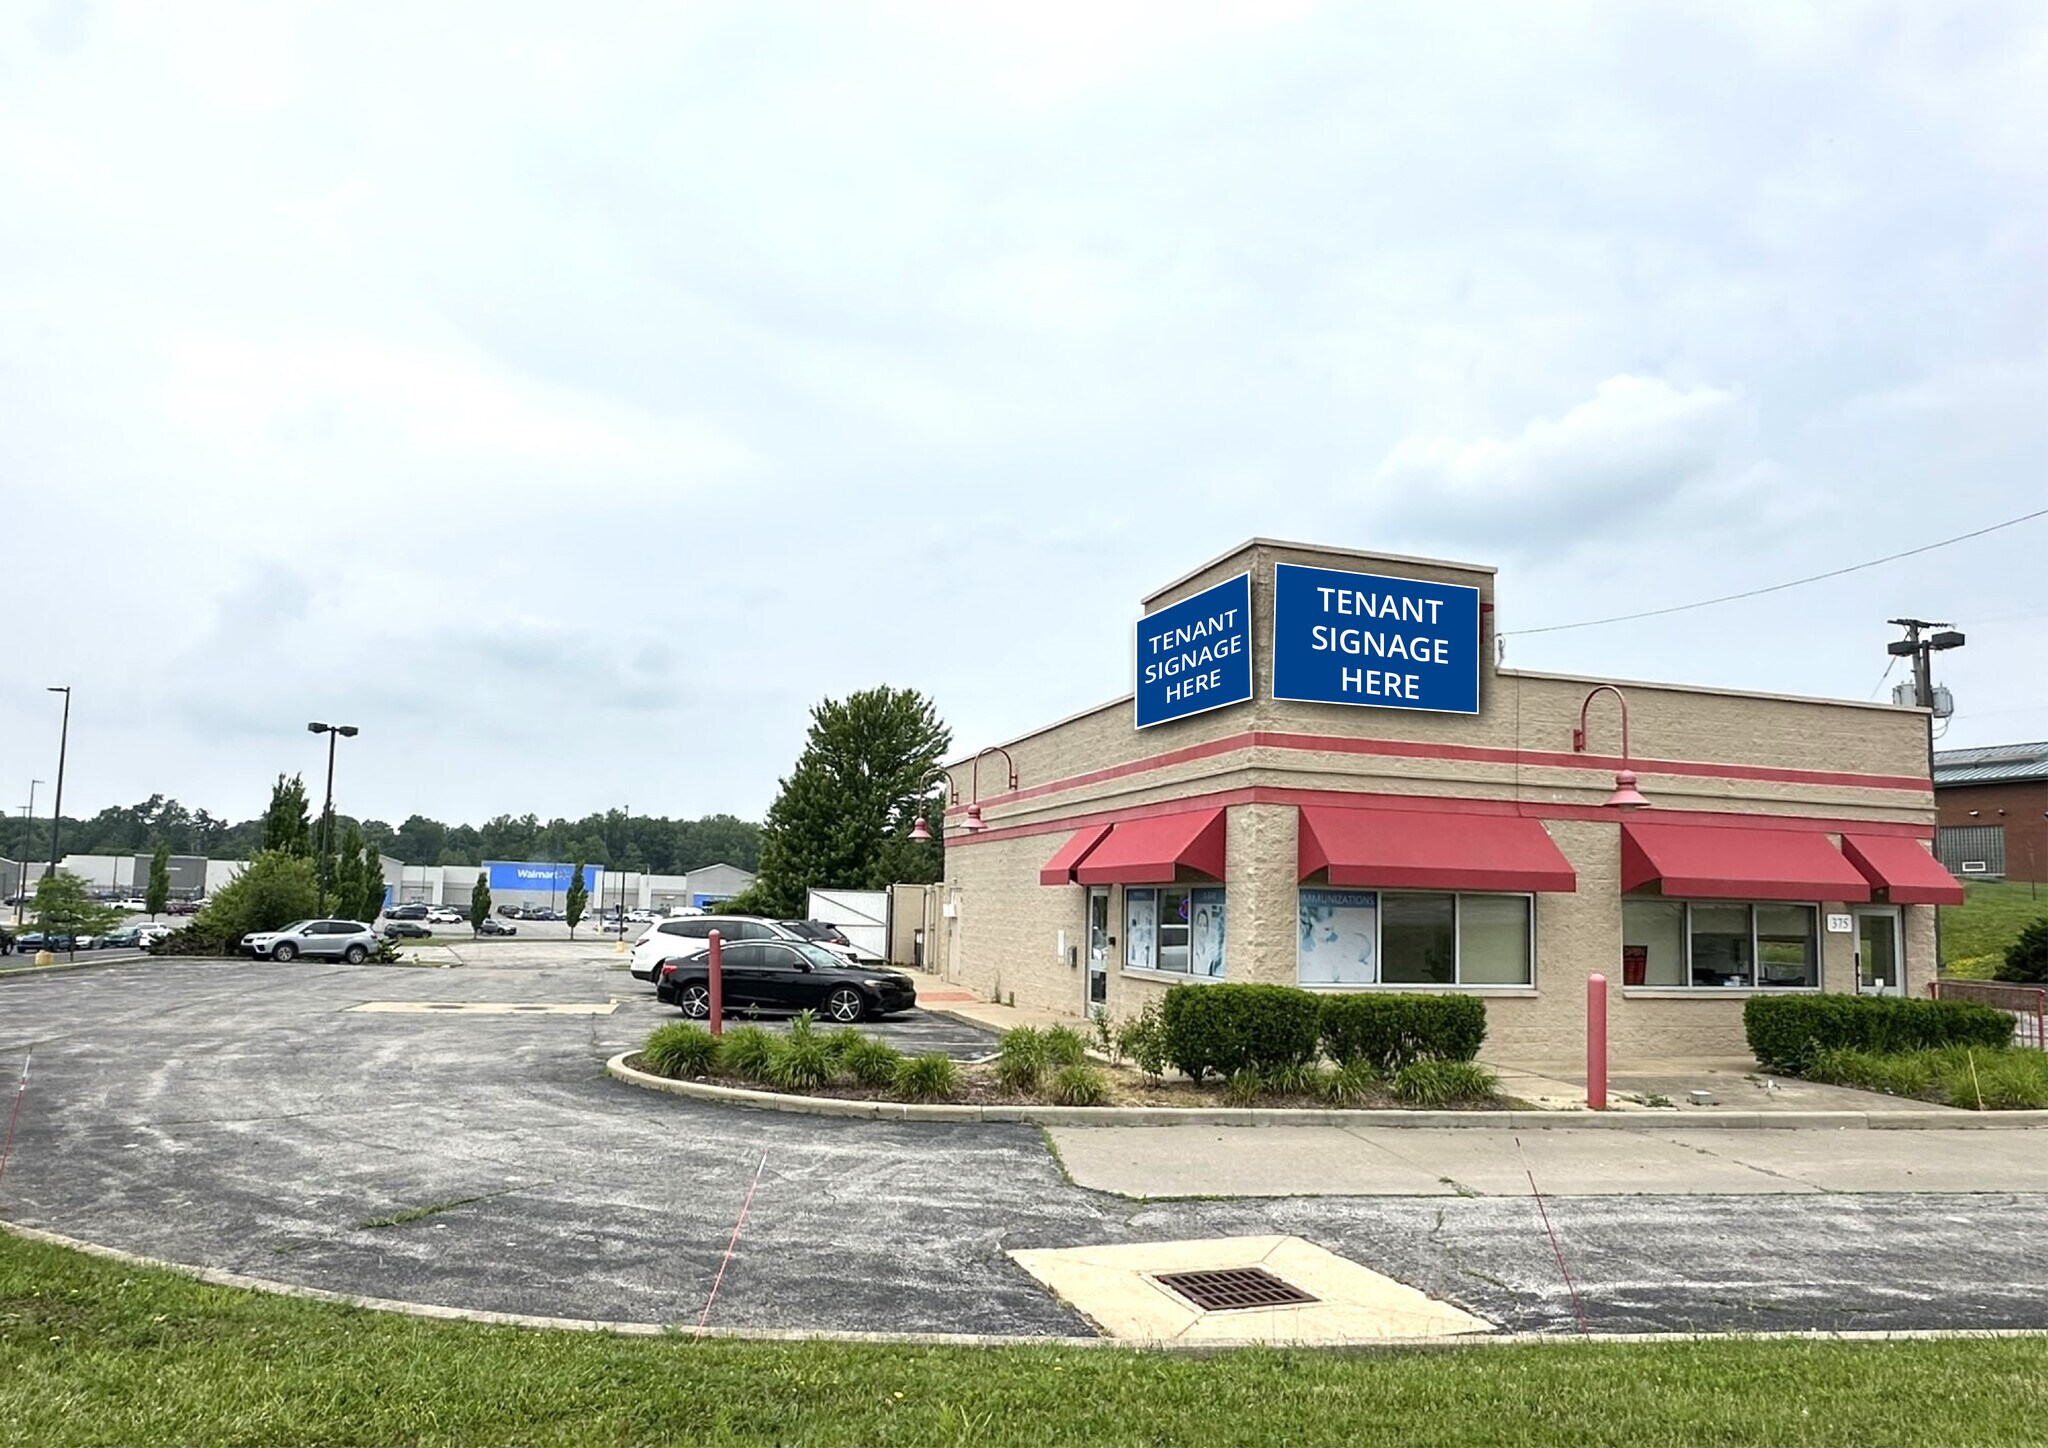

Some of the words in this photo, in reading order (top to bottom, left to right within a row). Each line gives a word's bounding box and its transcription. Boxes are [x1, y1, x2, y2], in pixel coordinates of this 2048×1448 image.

[1317, 587, 1443, 624] TENANT
[1149, 608, 1238, 655] TENANT
[1312, 625, 1449, 665] SIGNAGE
[1145, 634, 1242, 684] SIGNAGE
[1166, 668, 1221, 704] HERE
[1342, 666, 1420, 700] HERE
[517, 869, 558, 879] Walmart
[1831, 917, 1849, 929] 375
